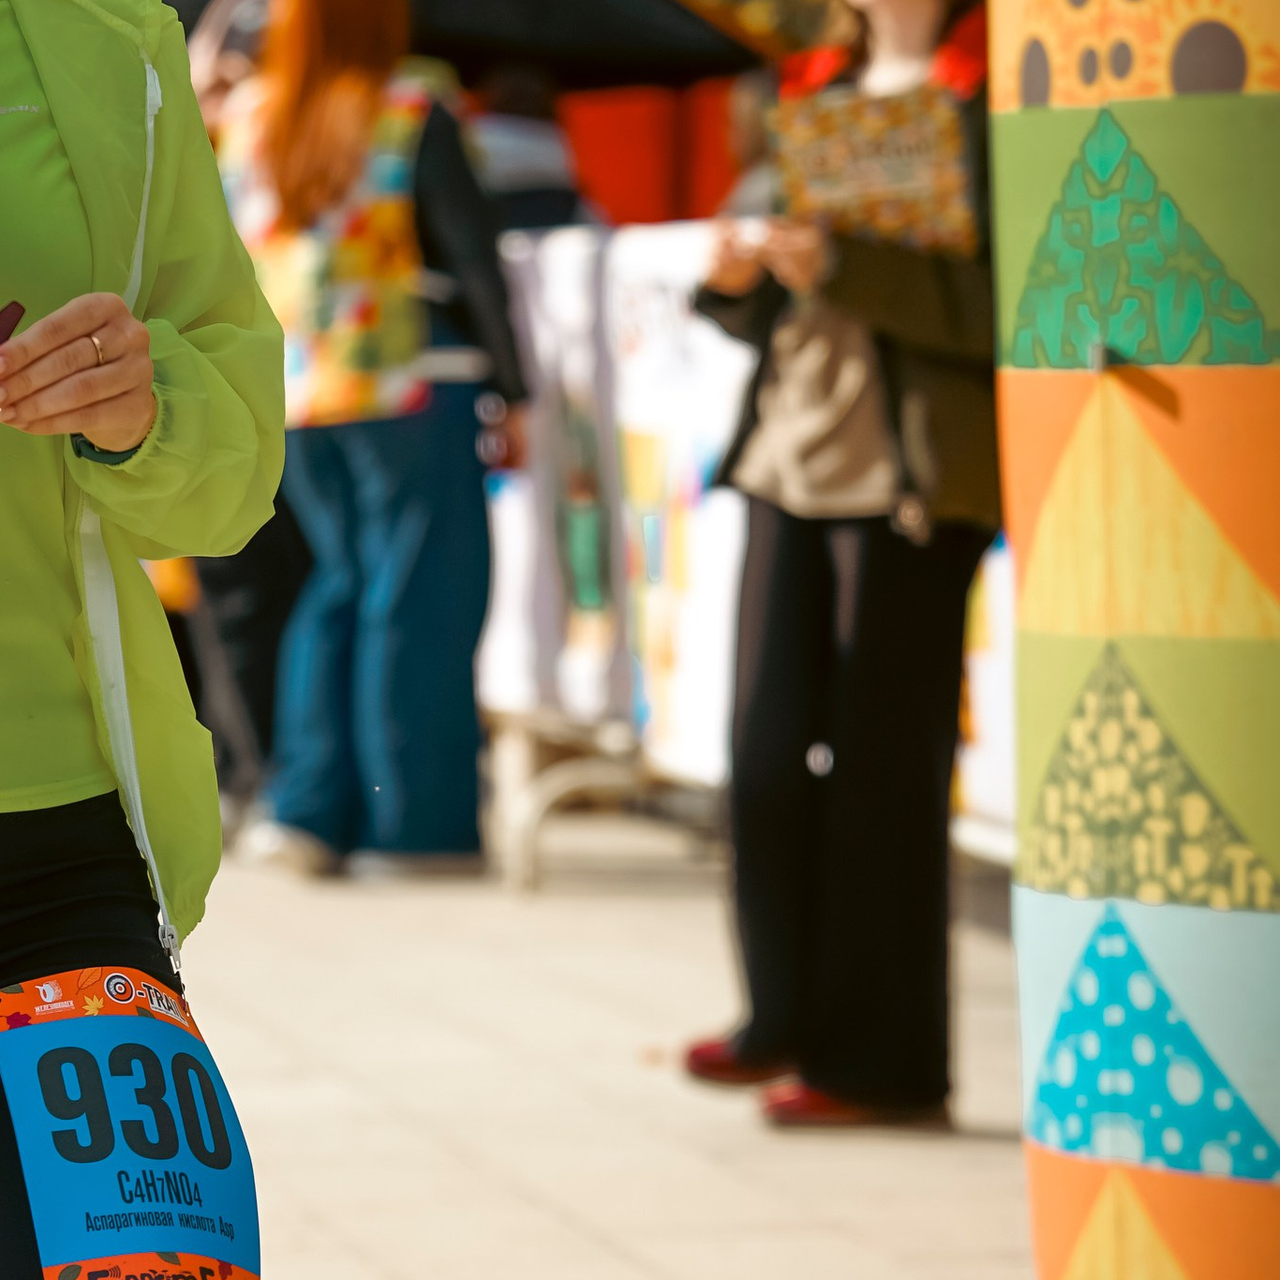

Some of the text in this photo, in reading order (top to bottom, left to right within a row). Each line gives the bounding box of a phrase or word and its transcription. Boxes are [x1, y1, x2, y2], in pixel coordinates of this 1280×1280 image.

[36, 1042, 232, 1170] 930
[117, 1169, 203, 1208] C4H7NO4
[85, 1211, 235, 1242] Аспарагиновая кислота Asp
